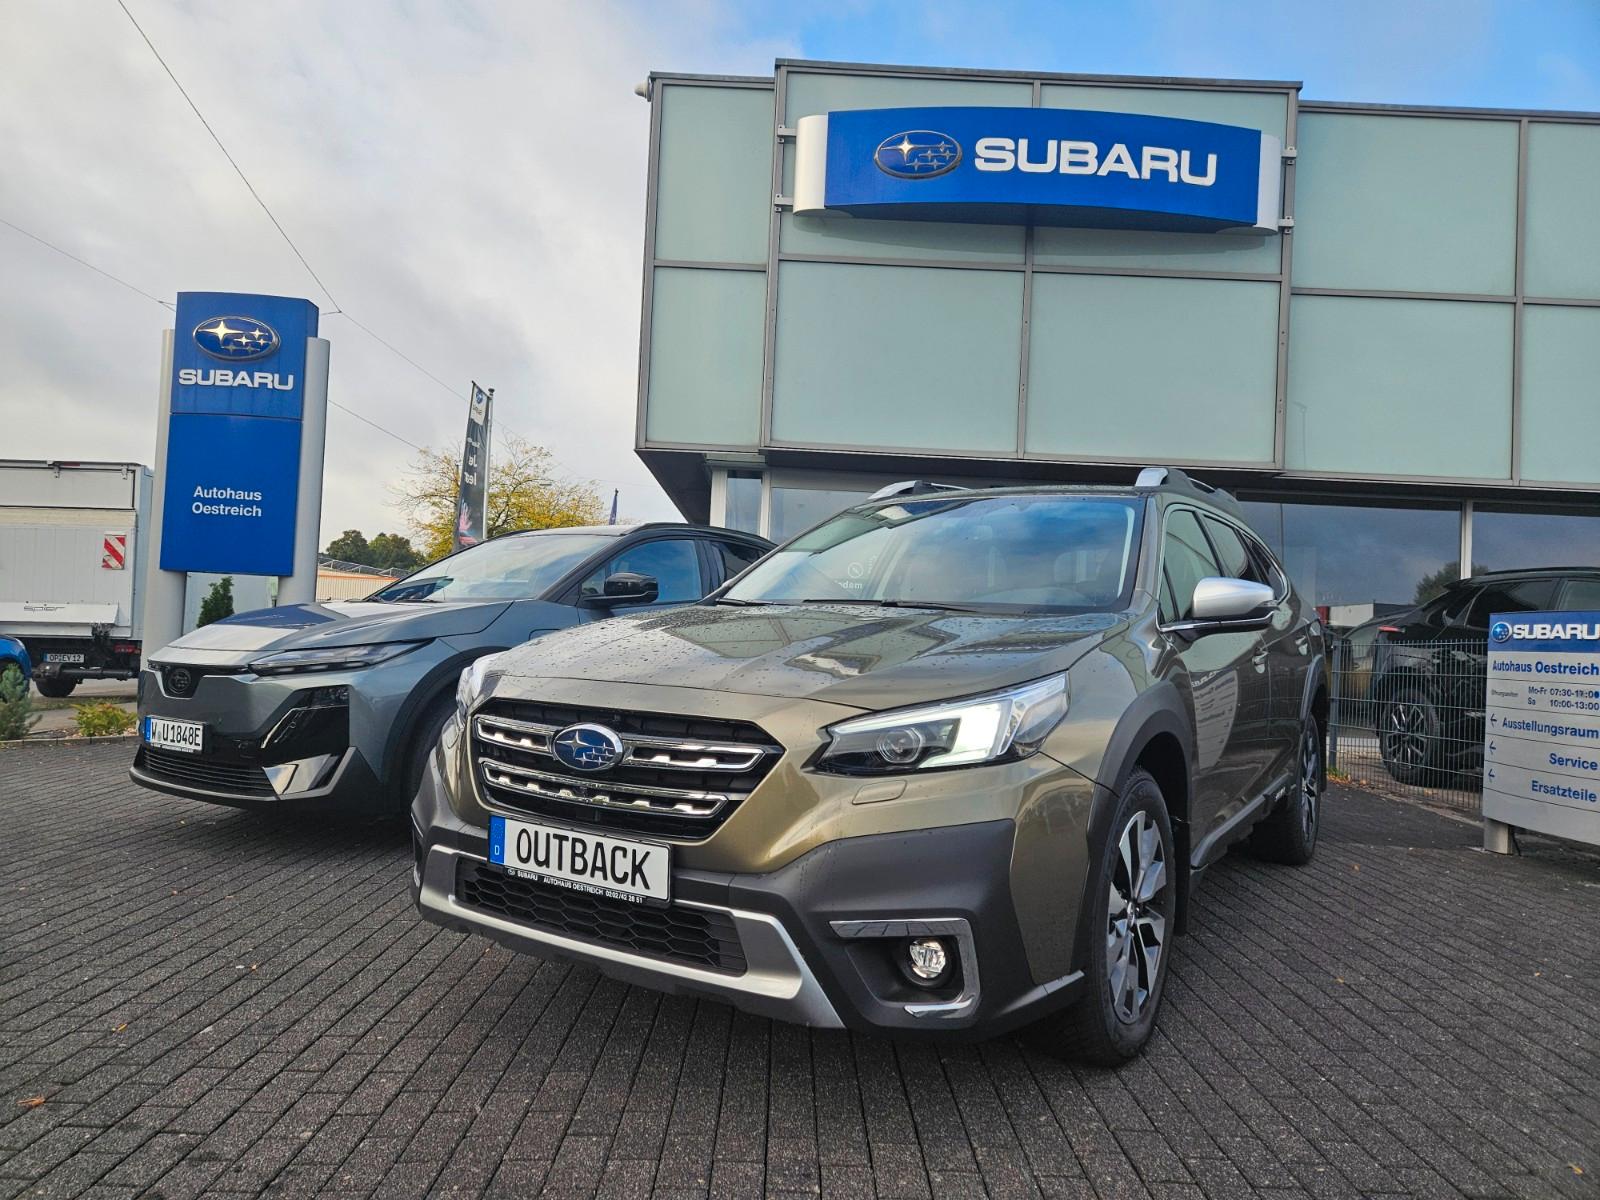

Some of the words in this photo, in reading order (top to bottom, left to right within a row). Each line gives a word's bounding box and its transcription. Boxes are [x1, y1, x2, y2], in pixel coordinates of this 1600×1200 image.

[974, 136, 1218, 187] SUBARU
[178, 369, 294, 391] SUBARU
[193, 485, 262, 501] Autohaus
[192, 502, 262, 517] Oestreich
[1512, 623, 1600, 640] SUBARU
[1492, 660, 1532, 673] Autohaus
[1535, 661, 1600, 676] Oestreich
[1528, 686, 1548, 695] Mo-Fr
[1527, 697, 1536, 706] Sa
[1550, 699, 1600, 711] 10:00-13:00
[1502, 717, 1599, 739] Ausstellungsraum
[1549, 753, 1599, 771] Service
[1531, 780, 1597, 802] Ersatzteile
[494, 845, 500, 856] D
[516, 828, 651, 890] OUTBACK
[517, 870, 538, 881] SUBARU
[543, 876, 572, 889] AUTOHAUS
